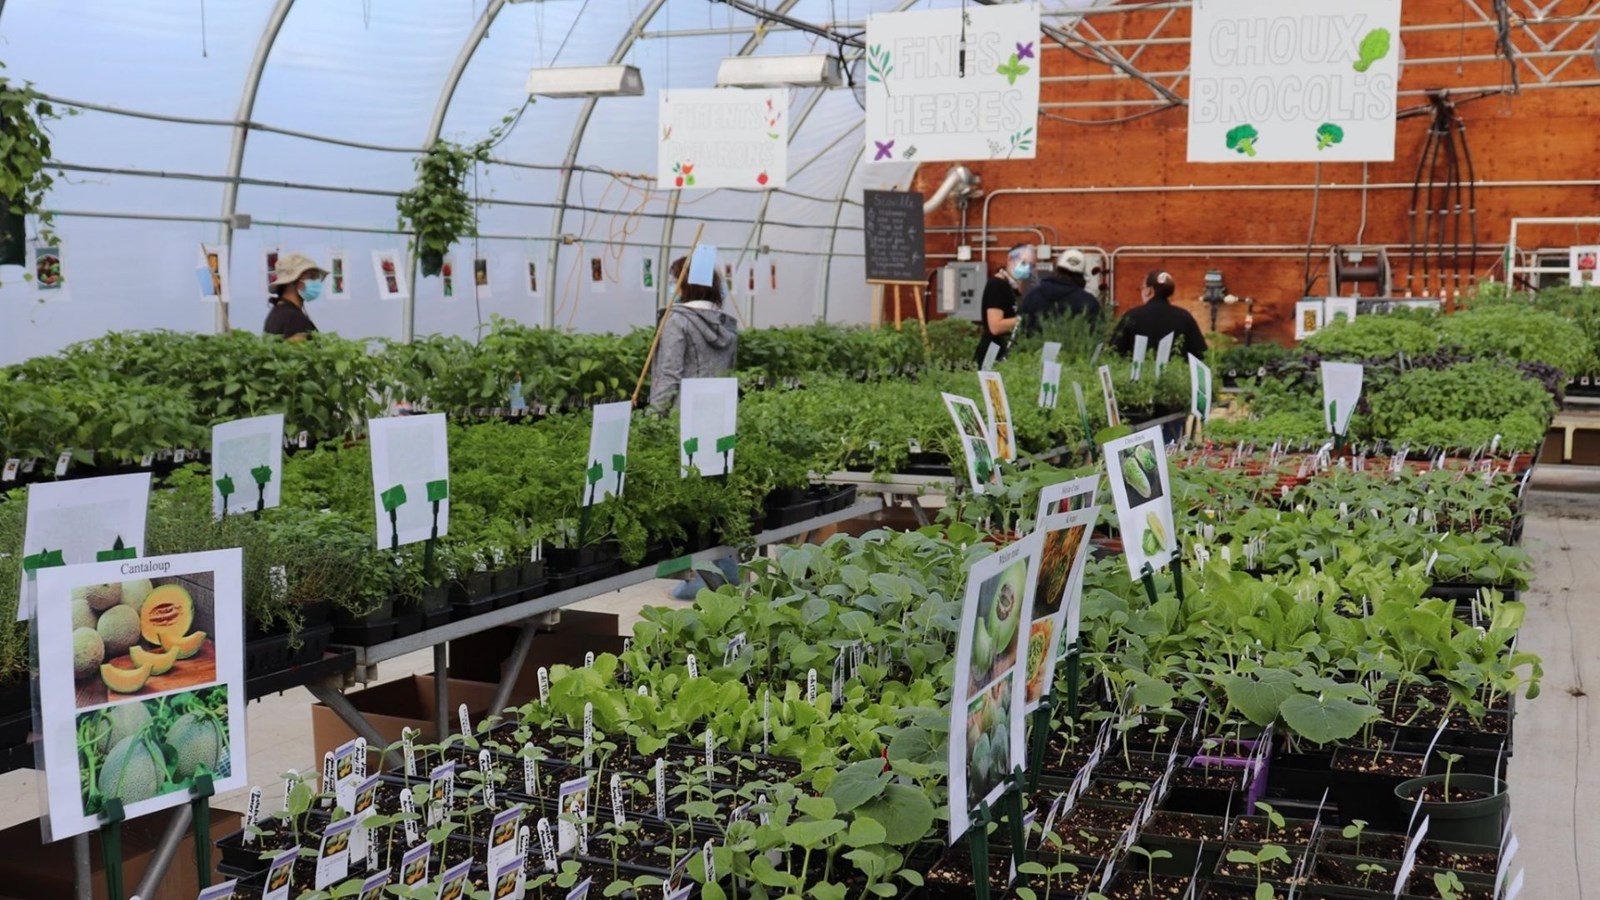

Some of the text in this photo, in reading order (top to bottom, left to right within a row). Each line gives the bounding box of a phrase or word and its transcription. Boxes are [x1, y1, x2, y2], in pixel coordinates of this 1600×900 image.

[1209, 13, 1367, 67] CHOUX
[885, 89, 1024, 137] HERBES
[120, 561, 171, 576] Cantaloup
